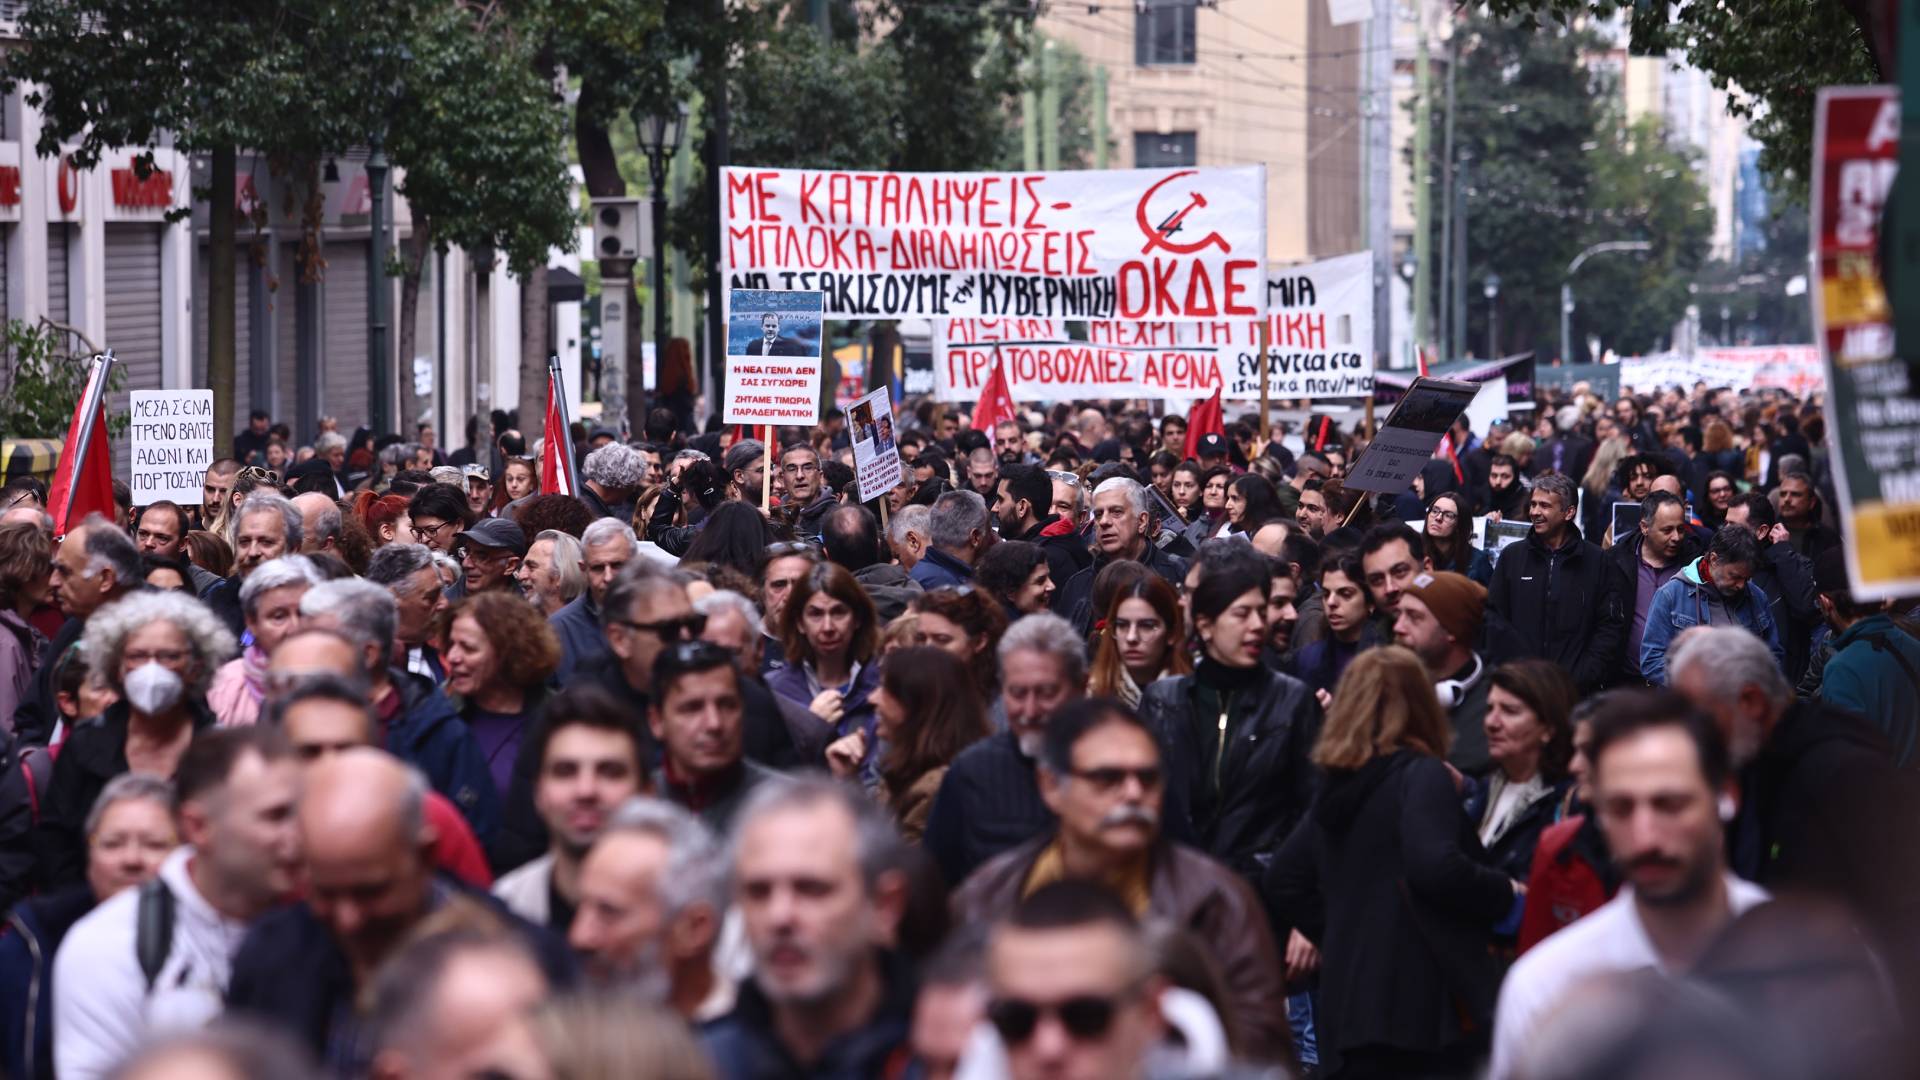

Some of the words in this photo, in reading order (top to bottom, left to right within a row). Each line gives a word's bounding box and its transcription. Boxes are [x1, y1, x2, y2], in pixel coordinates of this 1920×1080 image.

[728, 173, 781, 221] ΜΕ
[728, 225, 1098, 276] ΜΠΛΟΚΑ-ΔΙΑΔΗΛΩΣΕΙΣ
[979, 272, 1118, 319] ΚΥΒΕΡΝΗΣΗ
[1119, 256, 1258, 319] ΟΚΔΕ
[733, 366, 741, 374] Η
[743, 366, 763, 374] ΝΕΑ
[765, 366, 792, 375] ΓΕΝΙΑ
[796, 367, 816, 375] ΔΕΝ
[948, 348, 1135, 389] ΠΡΤΟΒΟΥΛΙΕΣ
[1144, 353, 1223, 389] ΑΓΩΝΑ
[741, 378, 759, 386] ΣΑΣ
[761, 379, 807, 387] ΣΥΓΧΩΡΕΙ
[134, 399, 169, 417] ΜΕΣΑ
[735, 395, 772, 404] ΖΗΤΑΜΕ
[775, 396, 811, 405] ΤΙΜΩΡΙΑ
[732, 408, 813, 417] ΠΑΡΑΔΕΙΓΜΑΤΙΚΗ
[132, 423, 176, 441] ΤΡΕΝΟ
[180, 422, 213, 440] ΒΑΛΤΕ
[137, 448, 182, 465] ΑΔΩΝΙ
[187, 448, 207, 465] ΚΑΙ
[133, 471, 207, 490] ΠΟΡΤΟΣΑΛΤ
